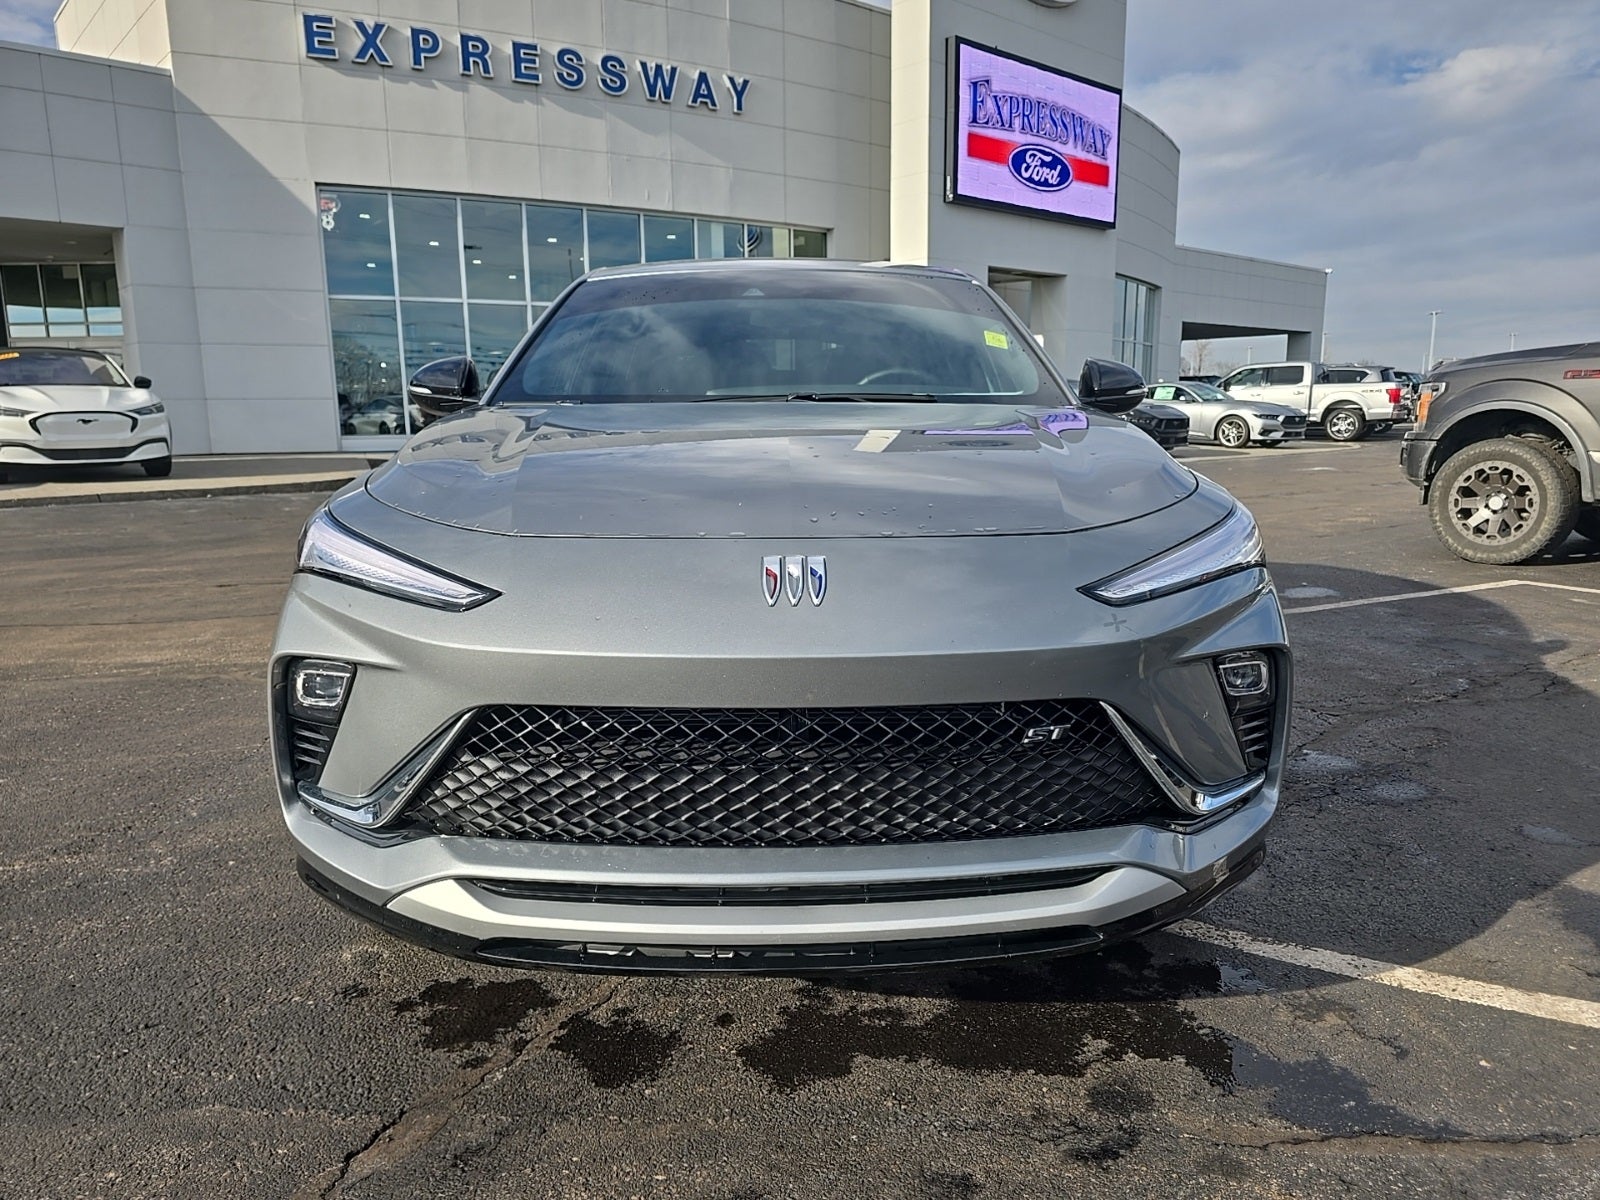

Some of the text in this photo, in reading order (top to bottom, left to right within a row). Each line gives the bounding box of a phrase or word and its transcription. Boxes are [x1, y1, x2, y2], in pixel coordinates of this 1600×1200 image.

[302, 12, 751, 114] EXPRESSWAY
[968, 77, 1112, 160] EXPRESSWAY
[1021, 150, 1063, 185] Ford
[1022, 724, 1072, 743] ST
